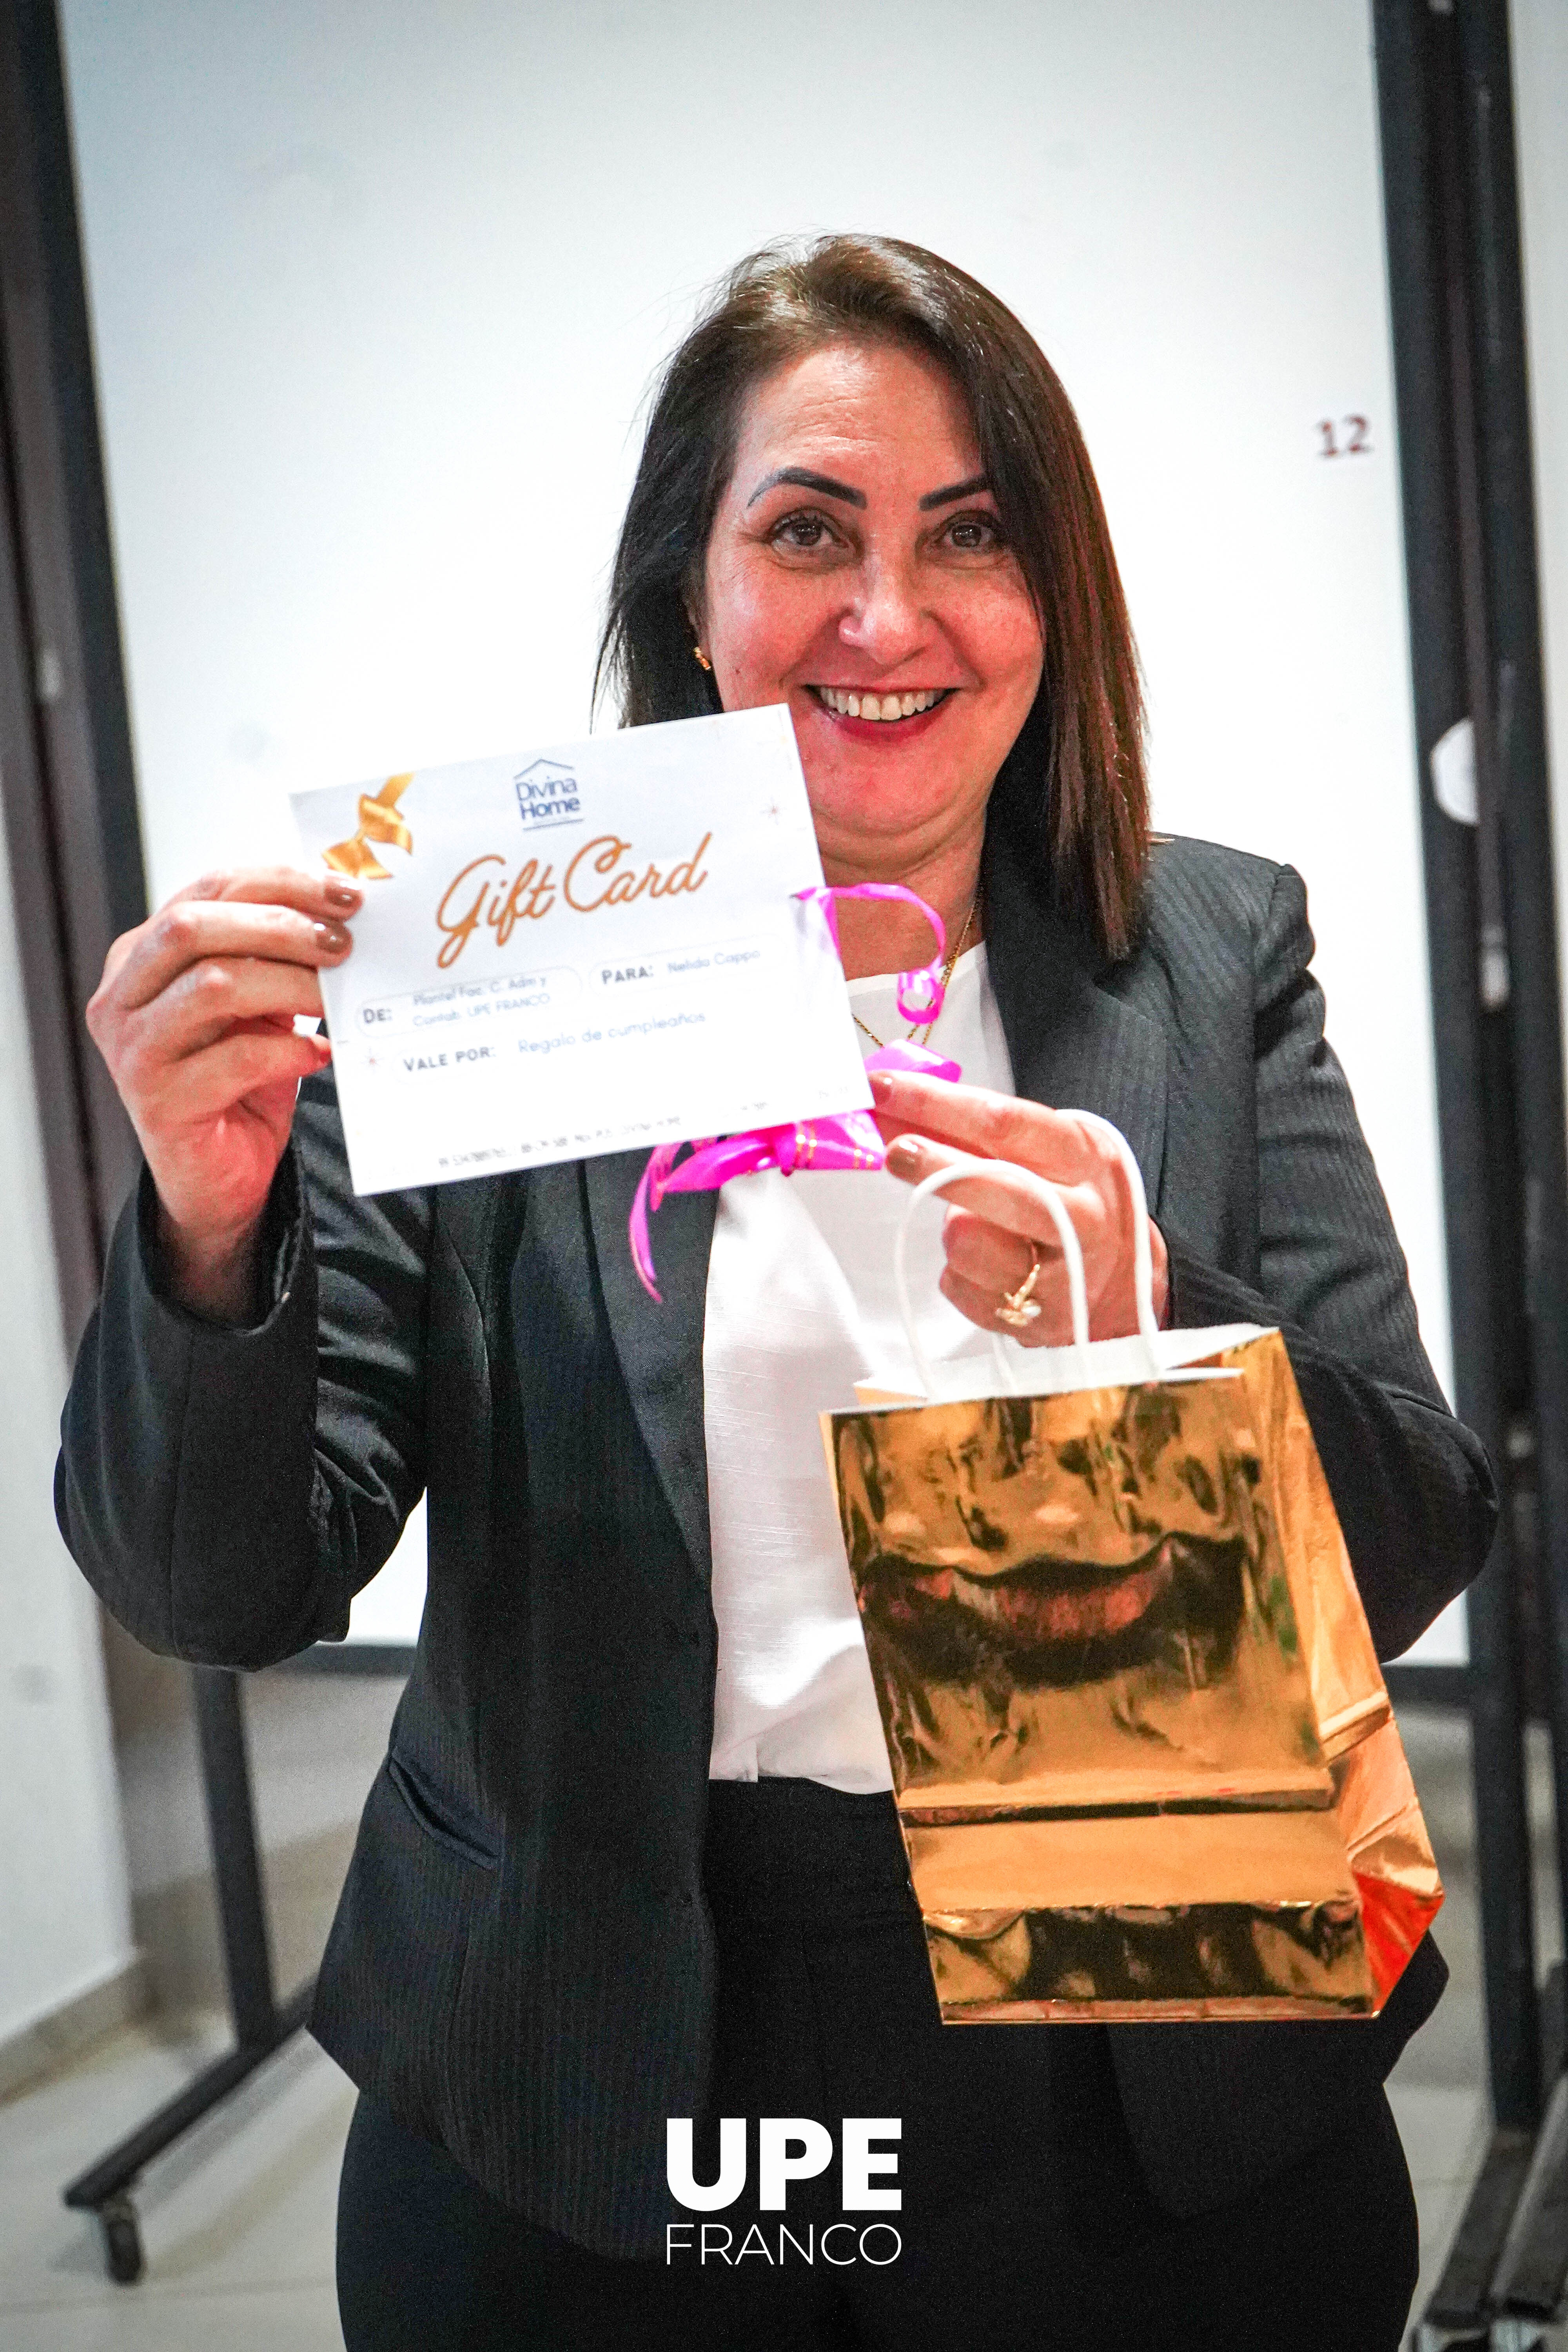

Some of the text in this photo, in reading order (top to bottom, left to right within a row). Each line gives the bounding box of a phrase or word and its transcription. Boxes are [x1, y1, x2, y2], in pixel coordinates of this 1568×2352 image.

[1316, 414, 1372, 456] 12
[516, 775, 578, 801] Divina
[519, 797, 580, 820] Home
[437, 832, 713, 969] Gift Card
[601, 965, 653, 984] PARA:
[495, 993, 550, 1011] FRANCO
[518, 1013, 706, 1054] Regalo de cumpleaños
[403, 1047, 496, 1072] VALE POR:
